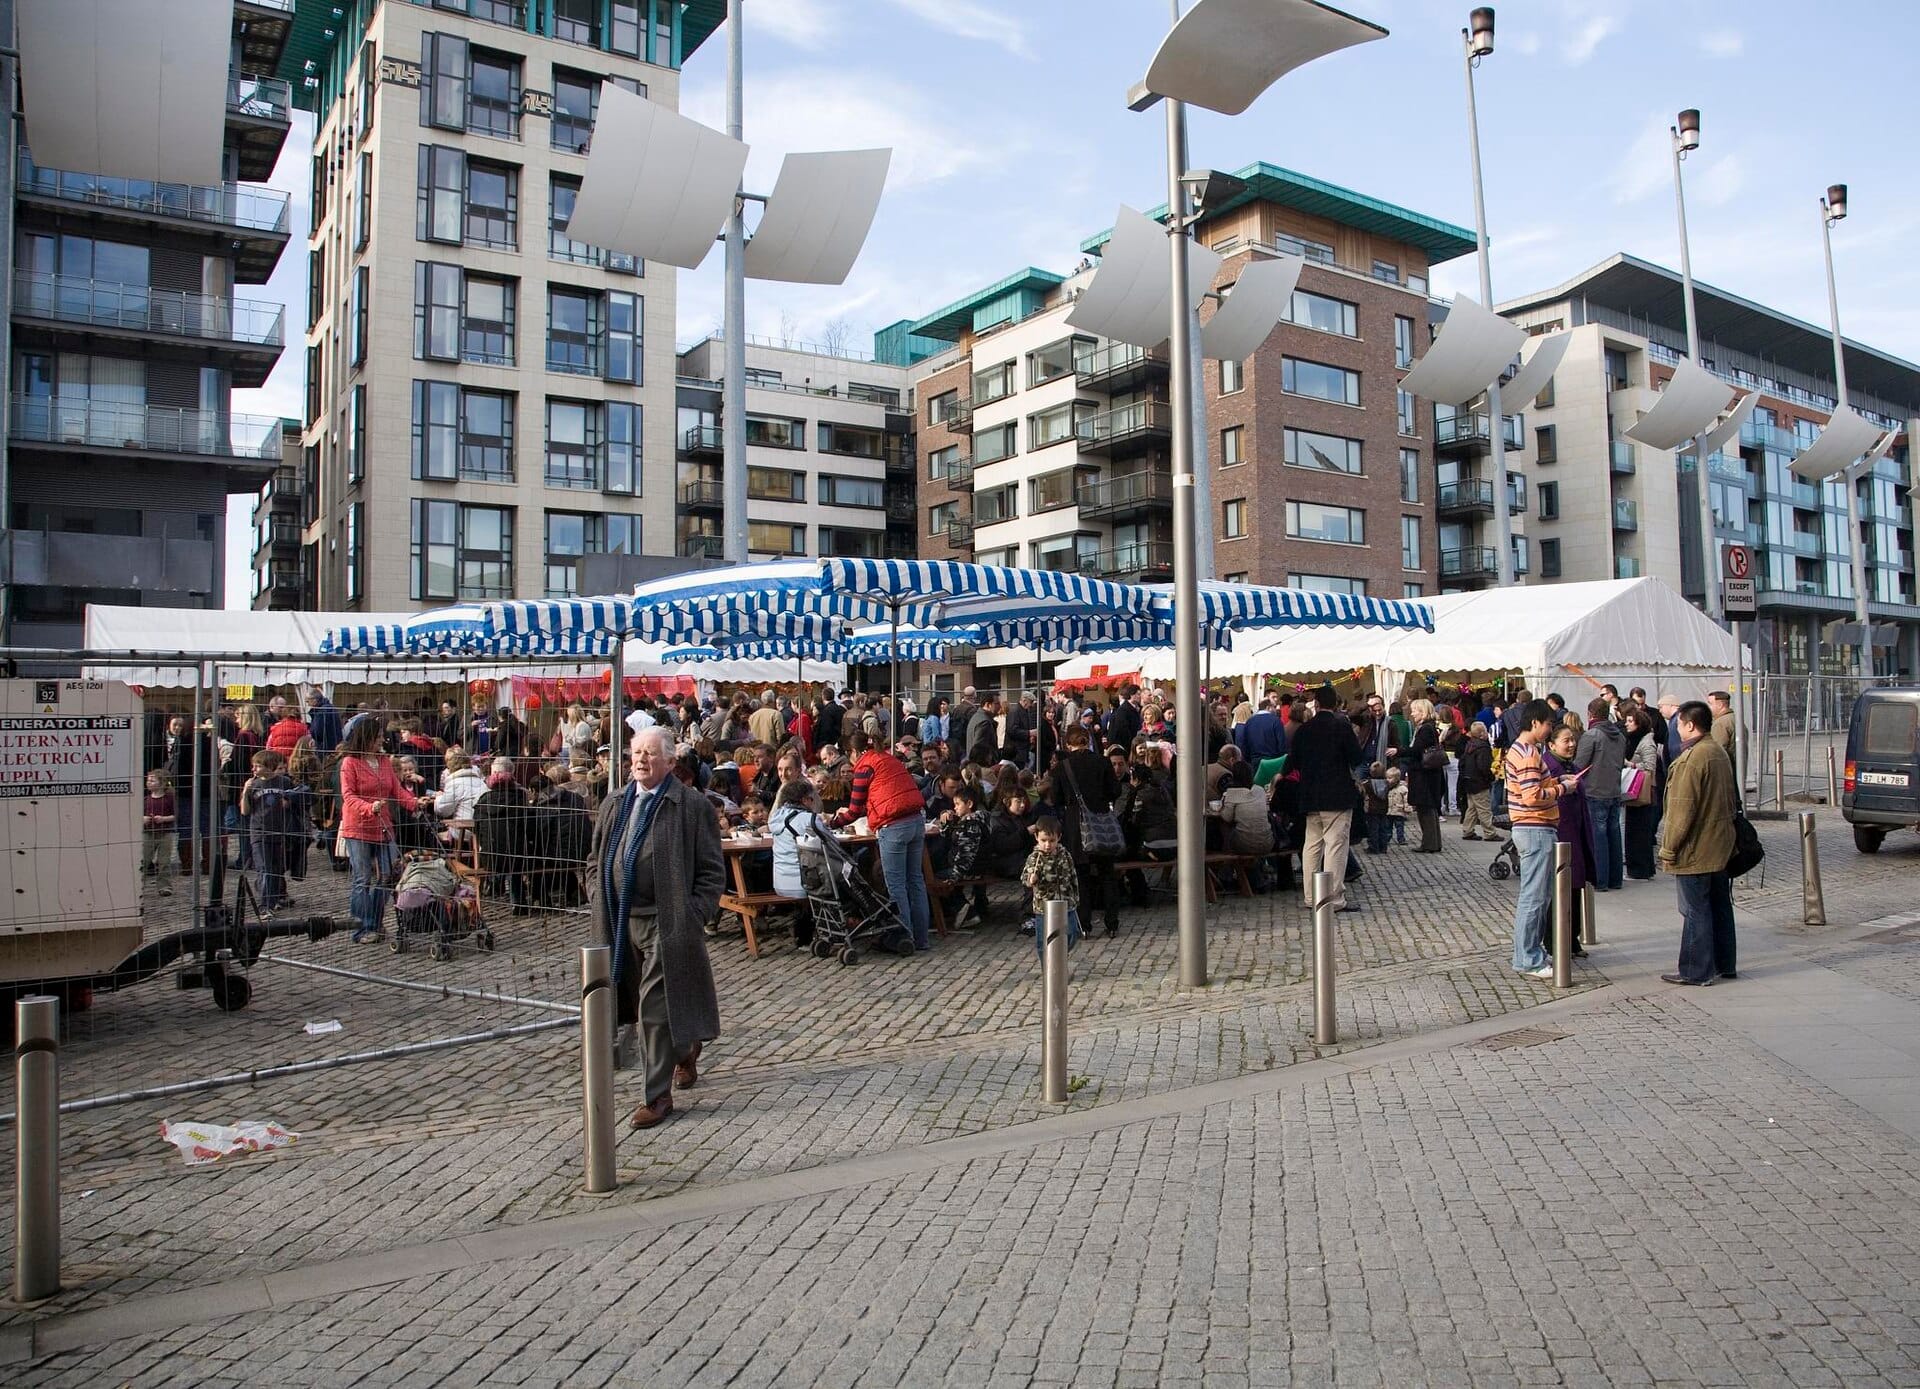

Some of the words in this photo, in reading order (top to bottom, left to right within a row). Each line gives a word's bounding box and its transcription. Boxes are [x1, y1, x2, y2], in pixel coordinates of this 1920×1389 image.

[1728, 595, 1752, 603] COACHES
[66, 681, 84, 690] AES
[86, 682, 104, 690] 1201
[42, 691, 55, 700] 92
[92, 718, 128, 728] HIRE
[0, 734, 114, 748] LTERNATIVE
[0, 752, 105, 766] LECTRICAL
